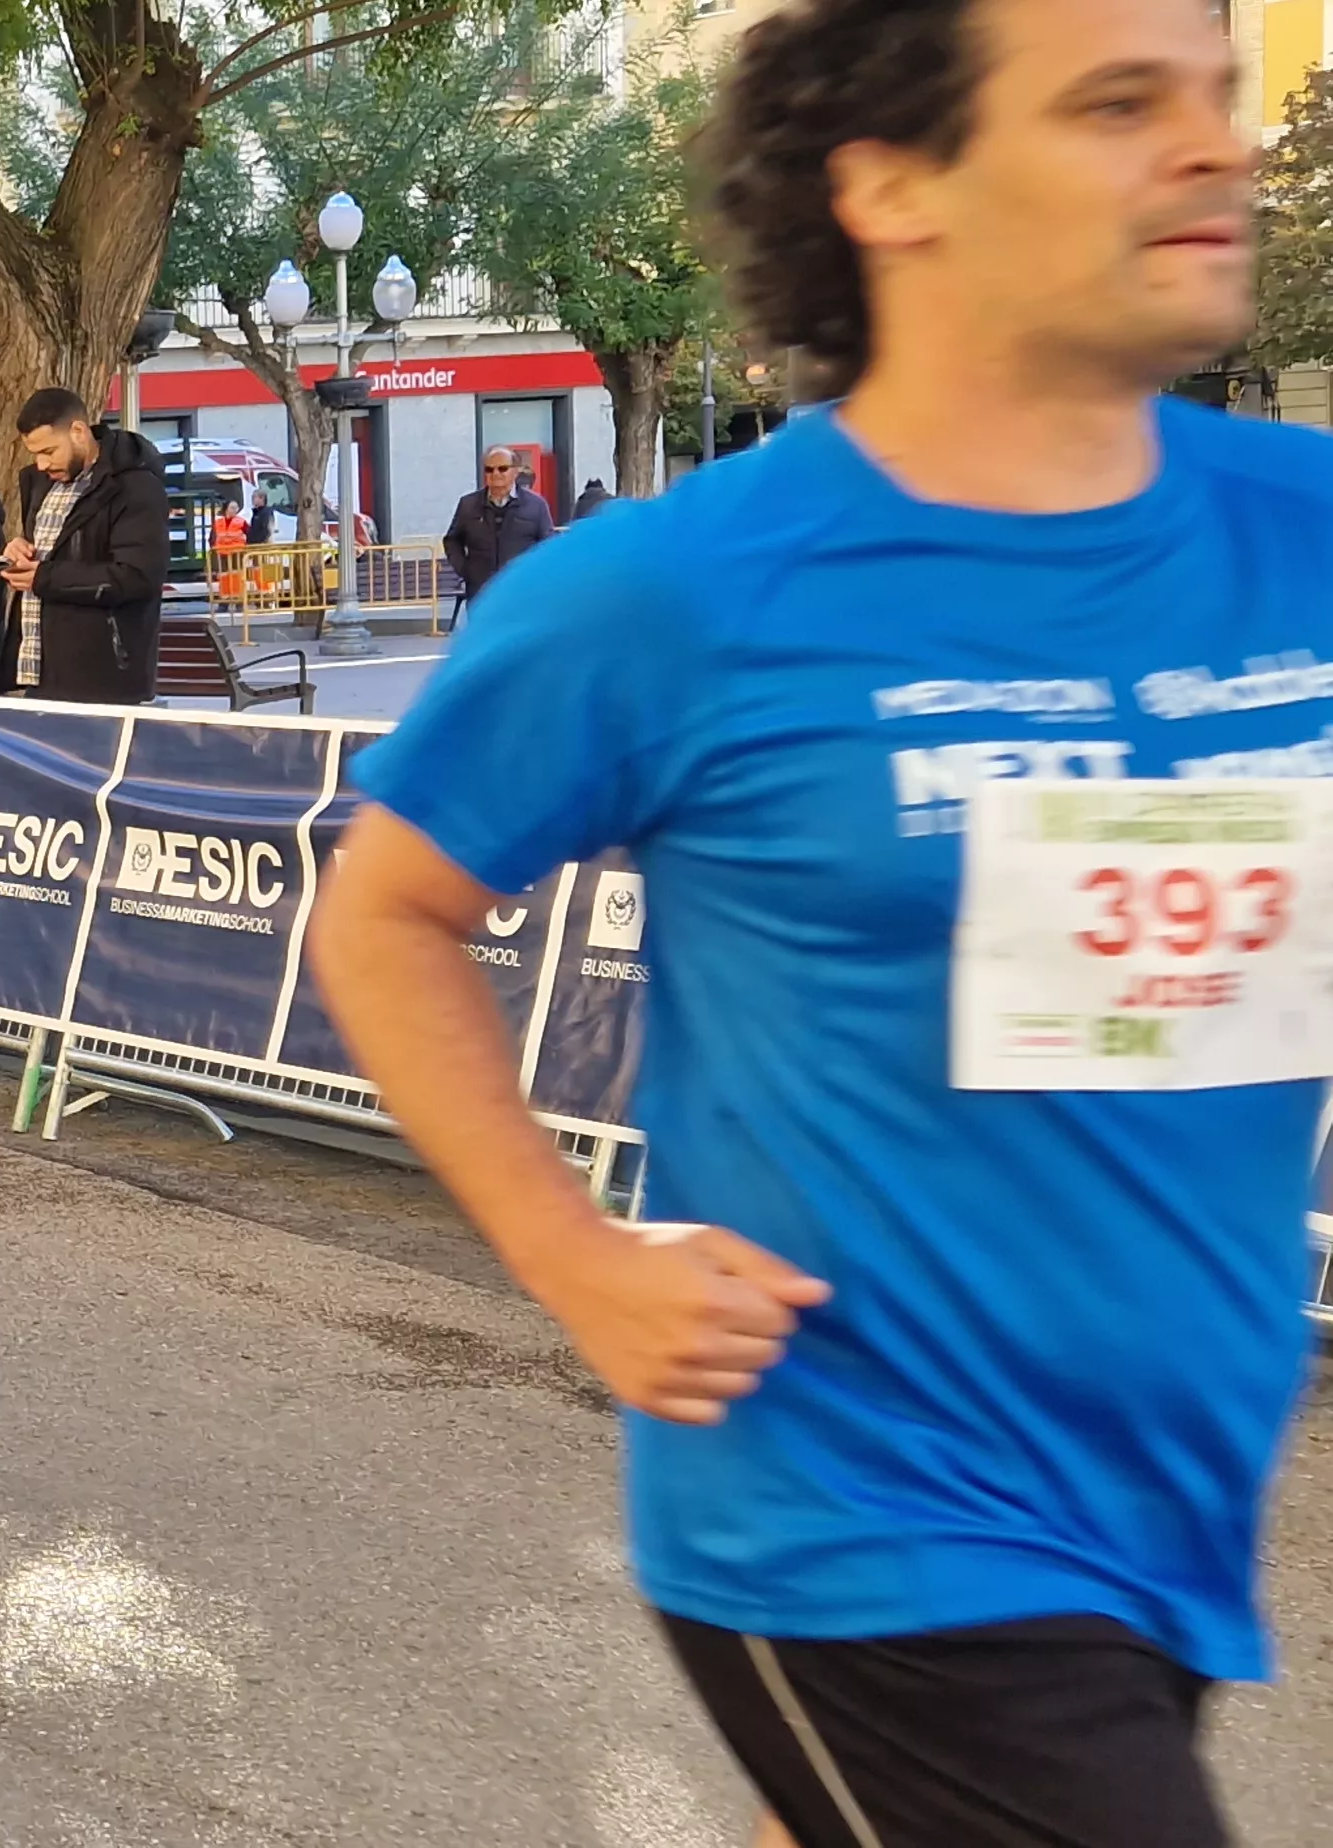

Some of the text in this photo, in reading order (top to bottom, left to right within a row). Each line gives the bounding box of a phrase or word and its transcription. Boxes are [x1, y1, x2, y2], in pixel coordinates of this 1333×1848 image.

[355, 366, 456, 391] antander
[158, 831, 285, 909] ESIC
[1073, 867, 1298, 957] 393
